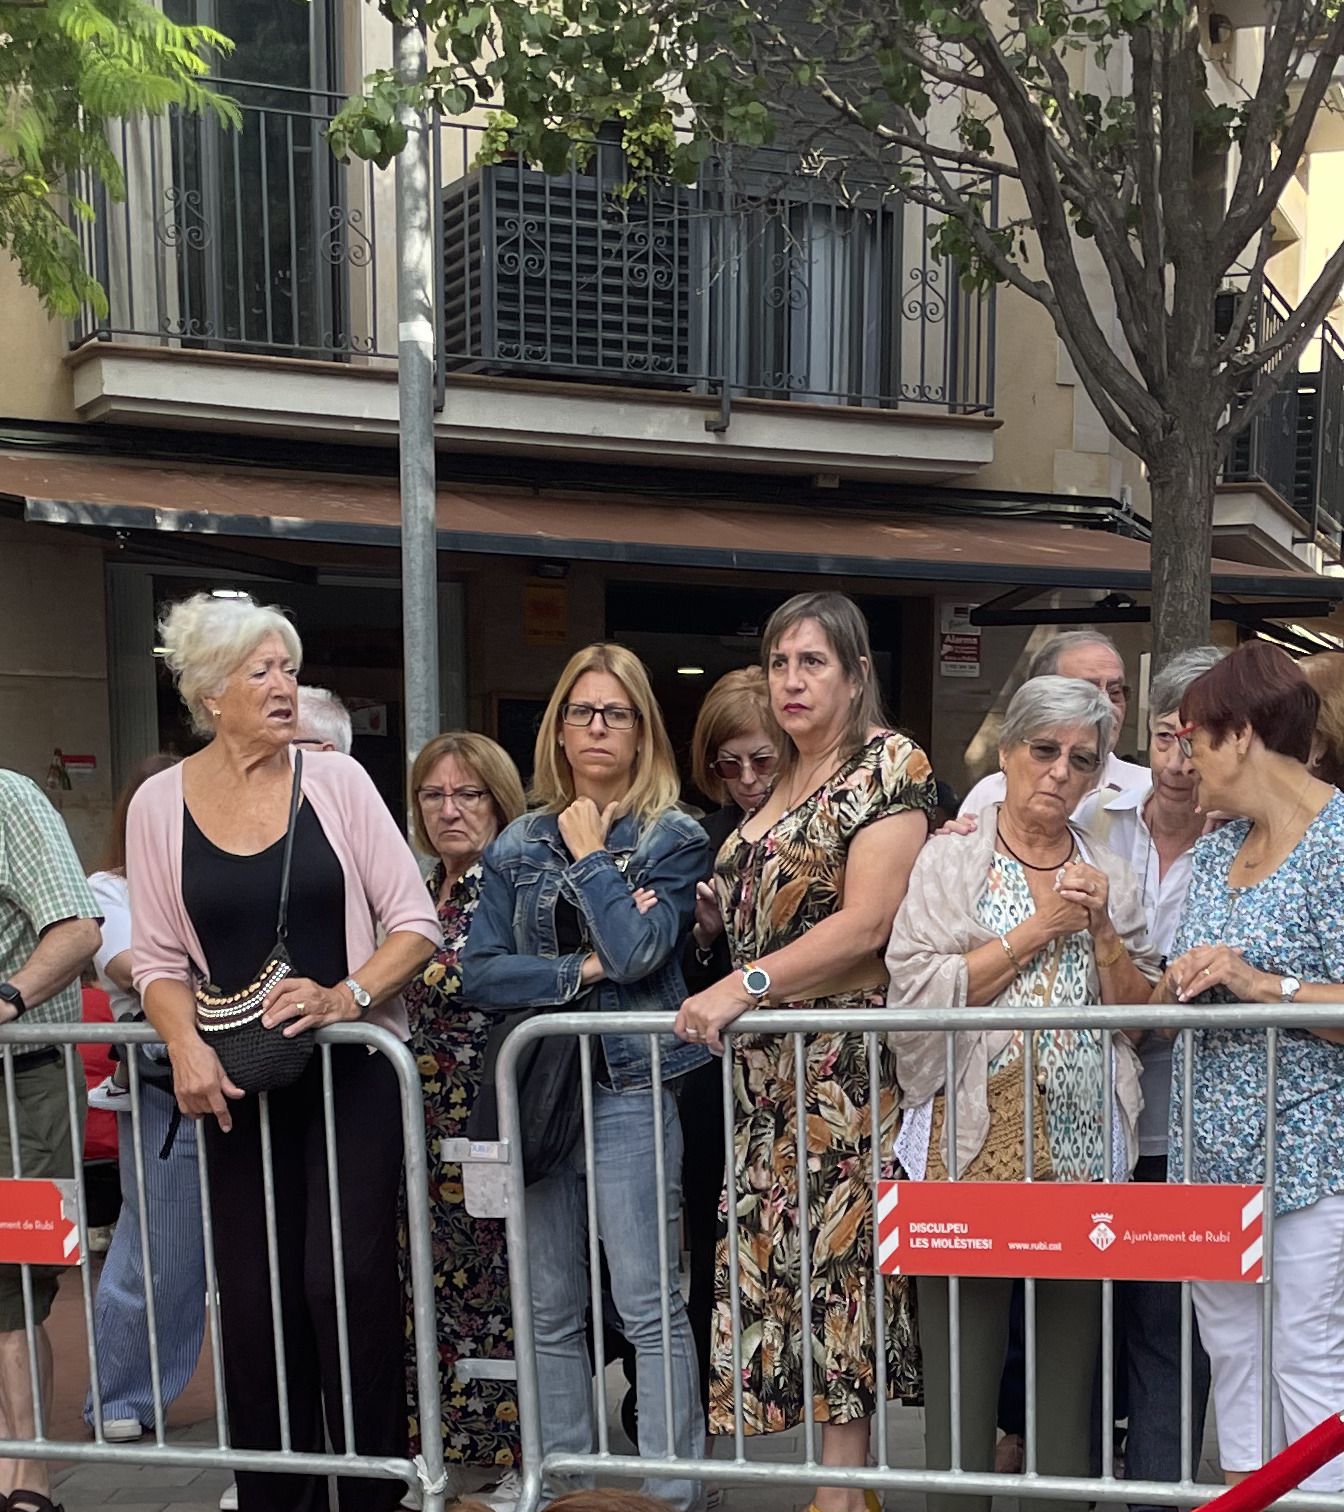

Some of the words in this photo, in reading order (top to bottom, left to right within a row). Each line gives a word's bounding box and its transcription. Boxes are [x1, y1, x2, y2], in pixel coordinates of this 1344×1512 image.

[22, 1220, 34, 1230] de
[909, 1222, 968, 1234] DISCULPEU
[1123, 1229, 1186, 1244] Ajuntament
[1188, 1230, 1203, 1242] de
[909, 1238, 929, 1249] LES
